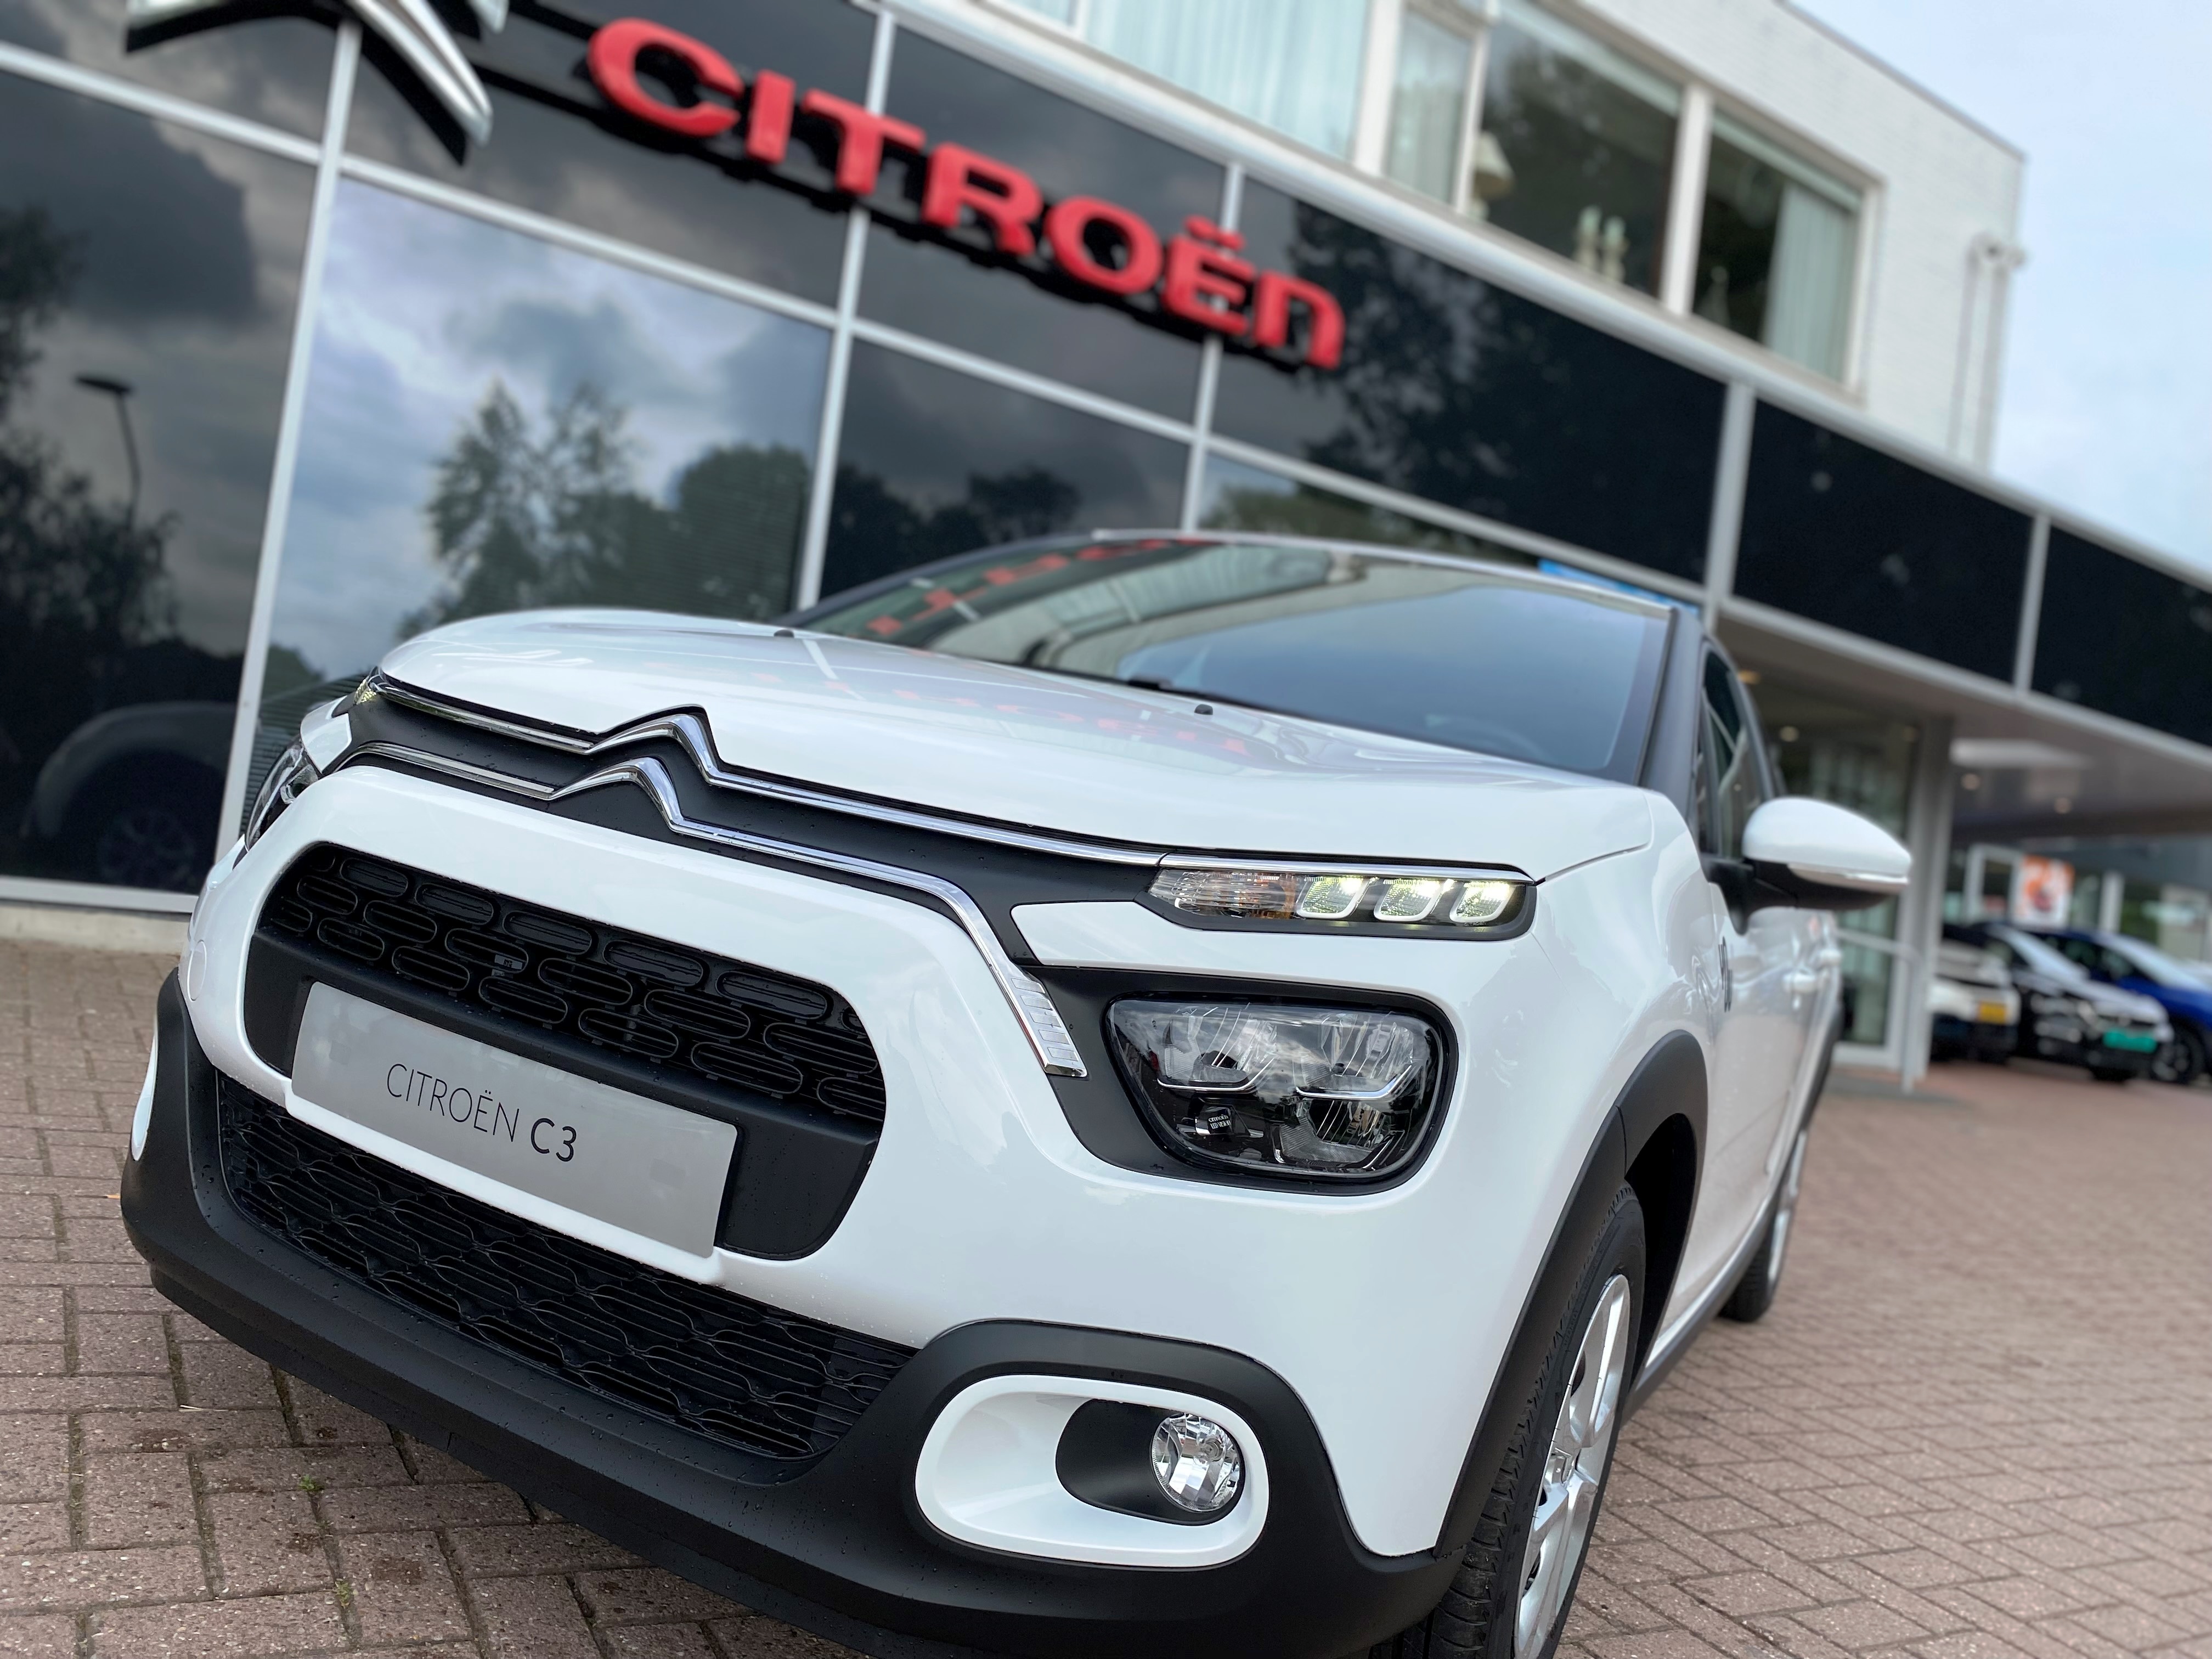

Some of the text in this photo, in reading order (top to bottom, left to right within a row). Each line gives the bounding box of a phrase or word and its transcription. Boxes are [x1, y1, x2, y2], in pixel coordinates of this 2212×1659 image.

[590, 19, 1344, 368] CITROËN
[387, 1063, 578, 1163] CITROËN C3
